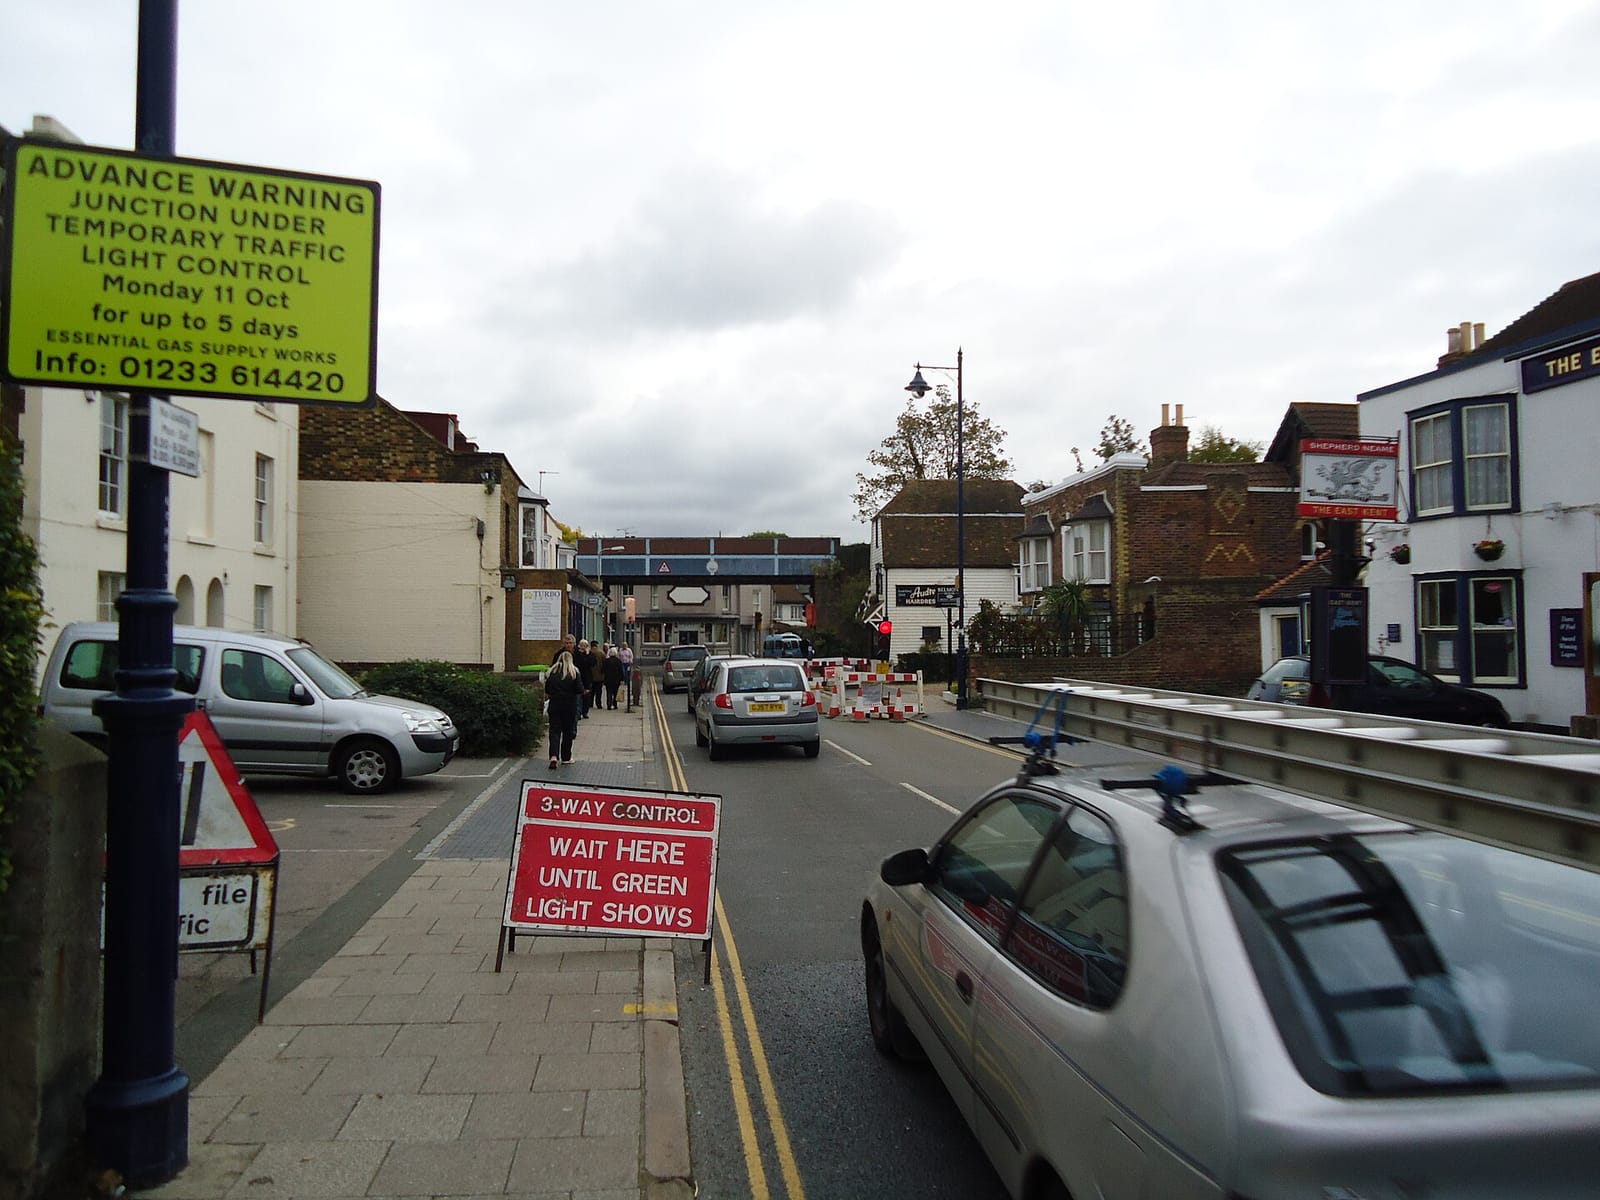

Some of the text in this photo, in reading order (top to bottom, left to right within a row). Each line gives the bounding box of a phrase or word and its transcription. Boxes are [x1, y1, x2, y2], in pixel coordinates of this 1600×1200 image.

[28, 155, 366, 215] ADVANCE WARNING
[70, 190, 326, 236] JUNCTION UNDER
[46, 213, 346, 263] TEMPORARY TRAFFIC
[82, 246, 310, 285] LIGHT CONTROL
[103, 274, 290, 309] Monday 11 Oct
[92, 303, 299, 340] for up to 5 days
[46, 329, 337, 365] ESSENTIAL GAS SUPPLY WORKS
[35, 350, 345, 394] Info: 01233 614420
[1545, 352, 1582, 377] THE
[1309, 442, 1395, 453] SHEPHERD NEAME
[1312, 506, 1388, 517] THE EAST KENT
[540, 796, 700, 824] 3-WAY CONTROL
[549, 836, 686, 865] WAIT HERE
[203, 884, 247, 905] file
[539, 866, 688, 896] UNTIL GREEN
[526, 897, 693, 928] LIGHT SHOWS
